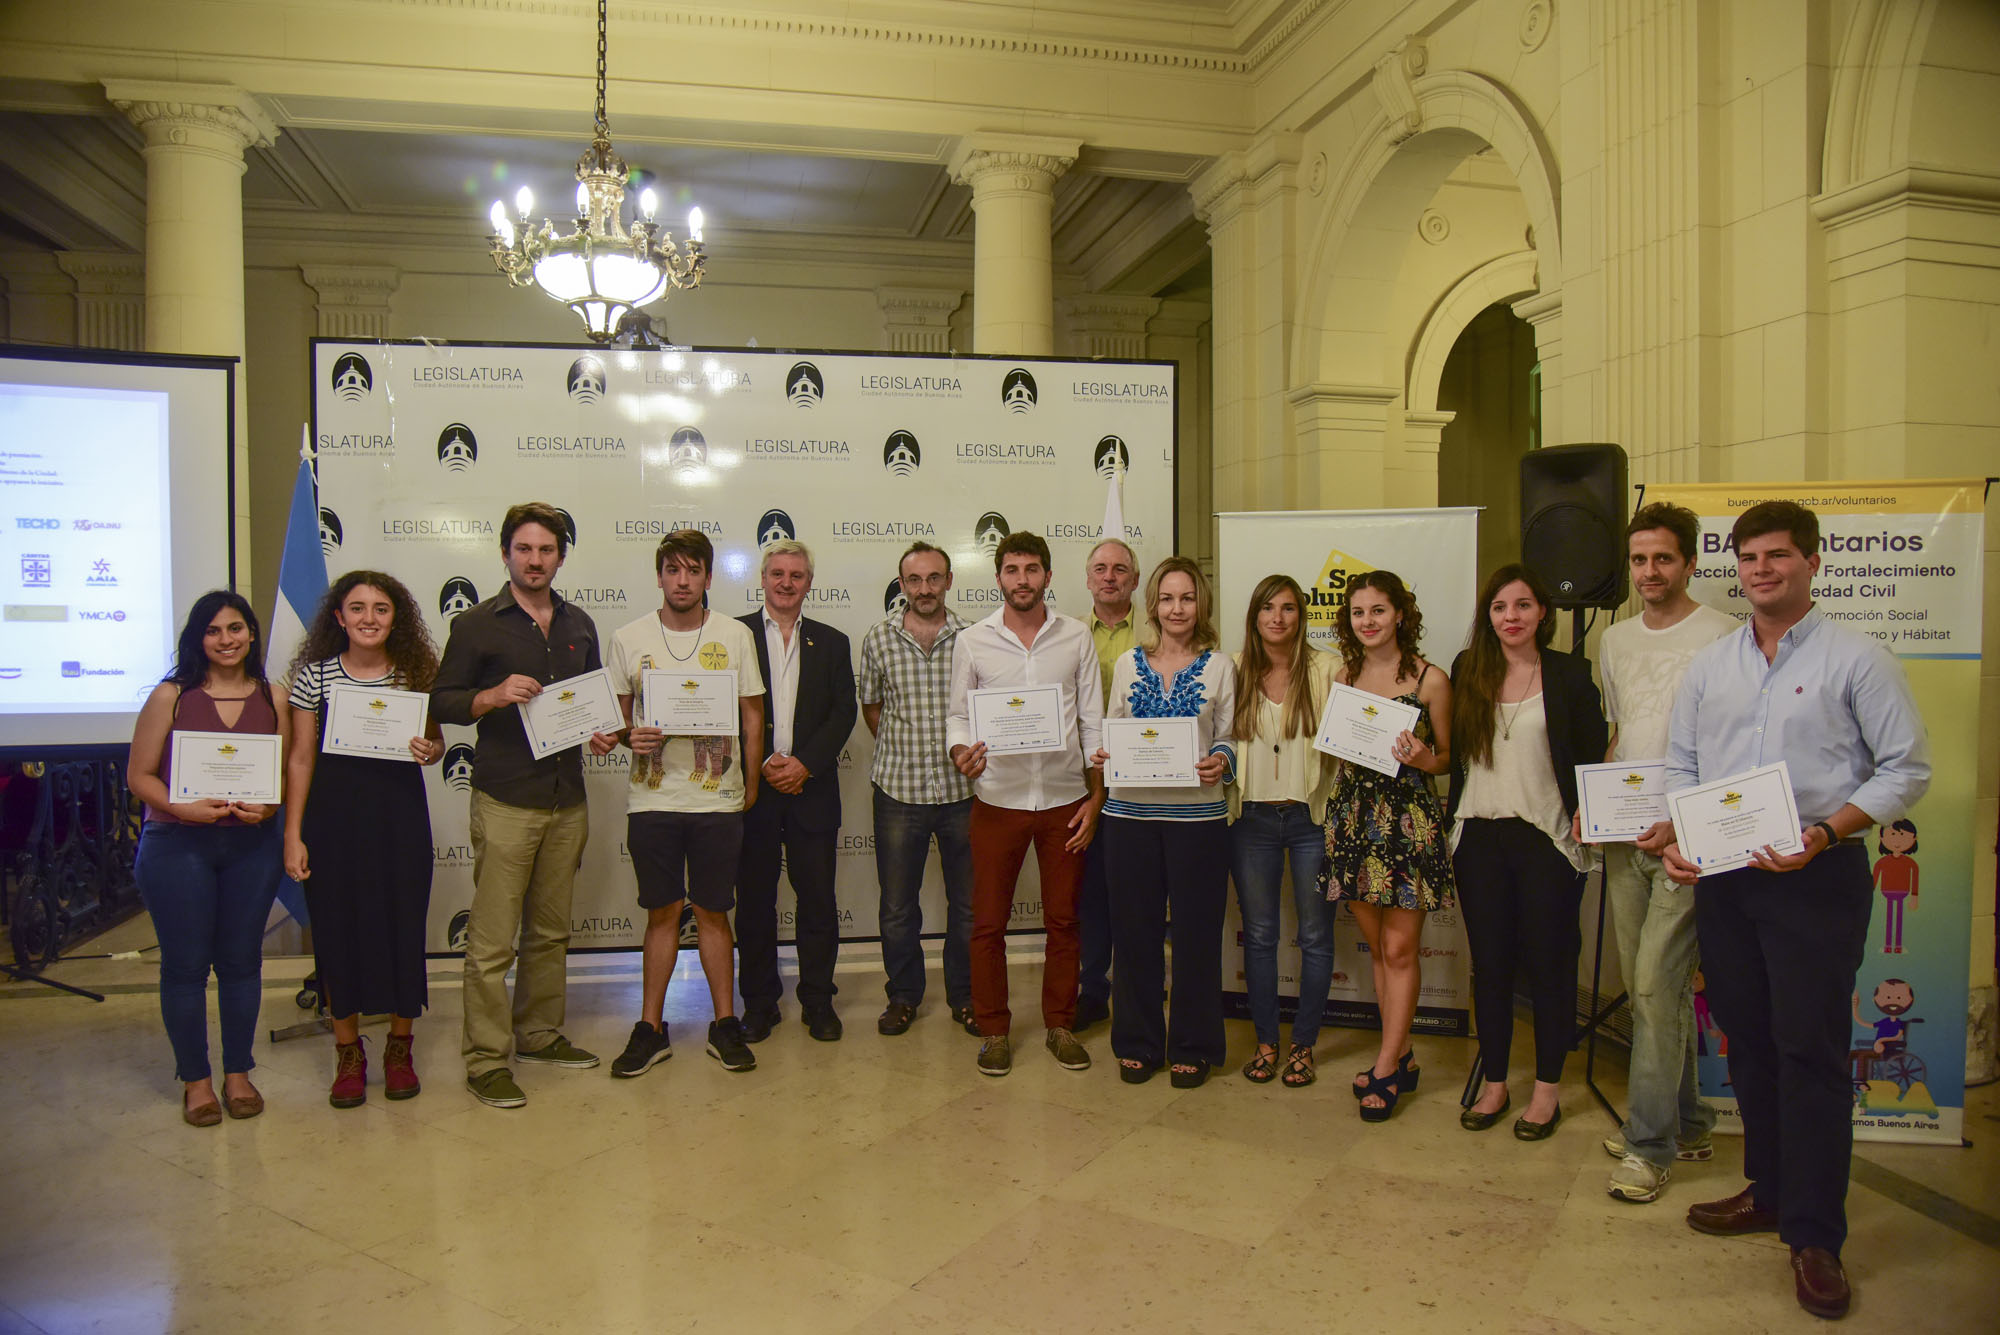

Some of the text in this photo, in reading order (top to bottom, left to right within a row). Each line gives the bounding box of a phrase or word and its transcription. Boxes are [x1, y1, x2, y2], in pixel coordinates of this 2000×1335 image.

[414, 366, 523, 381] LEGISLATURA
[645, 370, 752, 385] LEGISLATURA
[861, 375, 962, 391] LEGISLATURA
[1073, 382, 1169, 397] LEGISLATURA
[517, 436, 626, 451] LEGISLATURA
[745, 439, 850, 454] LEGISLATURA
[956, 443, 1056, 458] LEGISLATURA
[15, 518, 60, 529] TECHO
[383, 520, 493, 534] LEGISLATURA
[615, 520, 722, 534] LEGISLATURA
[833, 522, 935, 535] LEGISLATURA
[1046, 524, 1143, 538] LEGISLARA
[1824, 563, 1956, 577] Fortalecimiento
[1860, 584, 1896, 597] Civil
[79, 611, 113, 620] YMCA
[1827, 610, 1928, 621] omoción Social
[1891, 632, 1899, 643] y
[1903, 629, 1951, 640] Hábitat
[1878, 1119, 1911, 1128] Buenos
[1914, 1121, 1939, 1130] Aires
